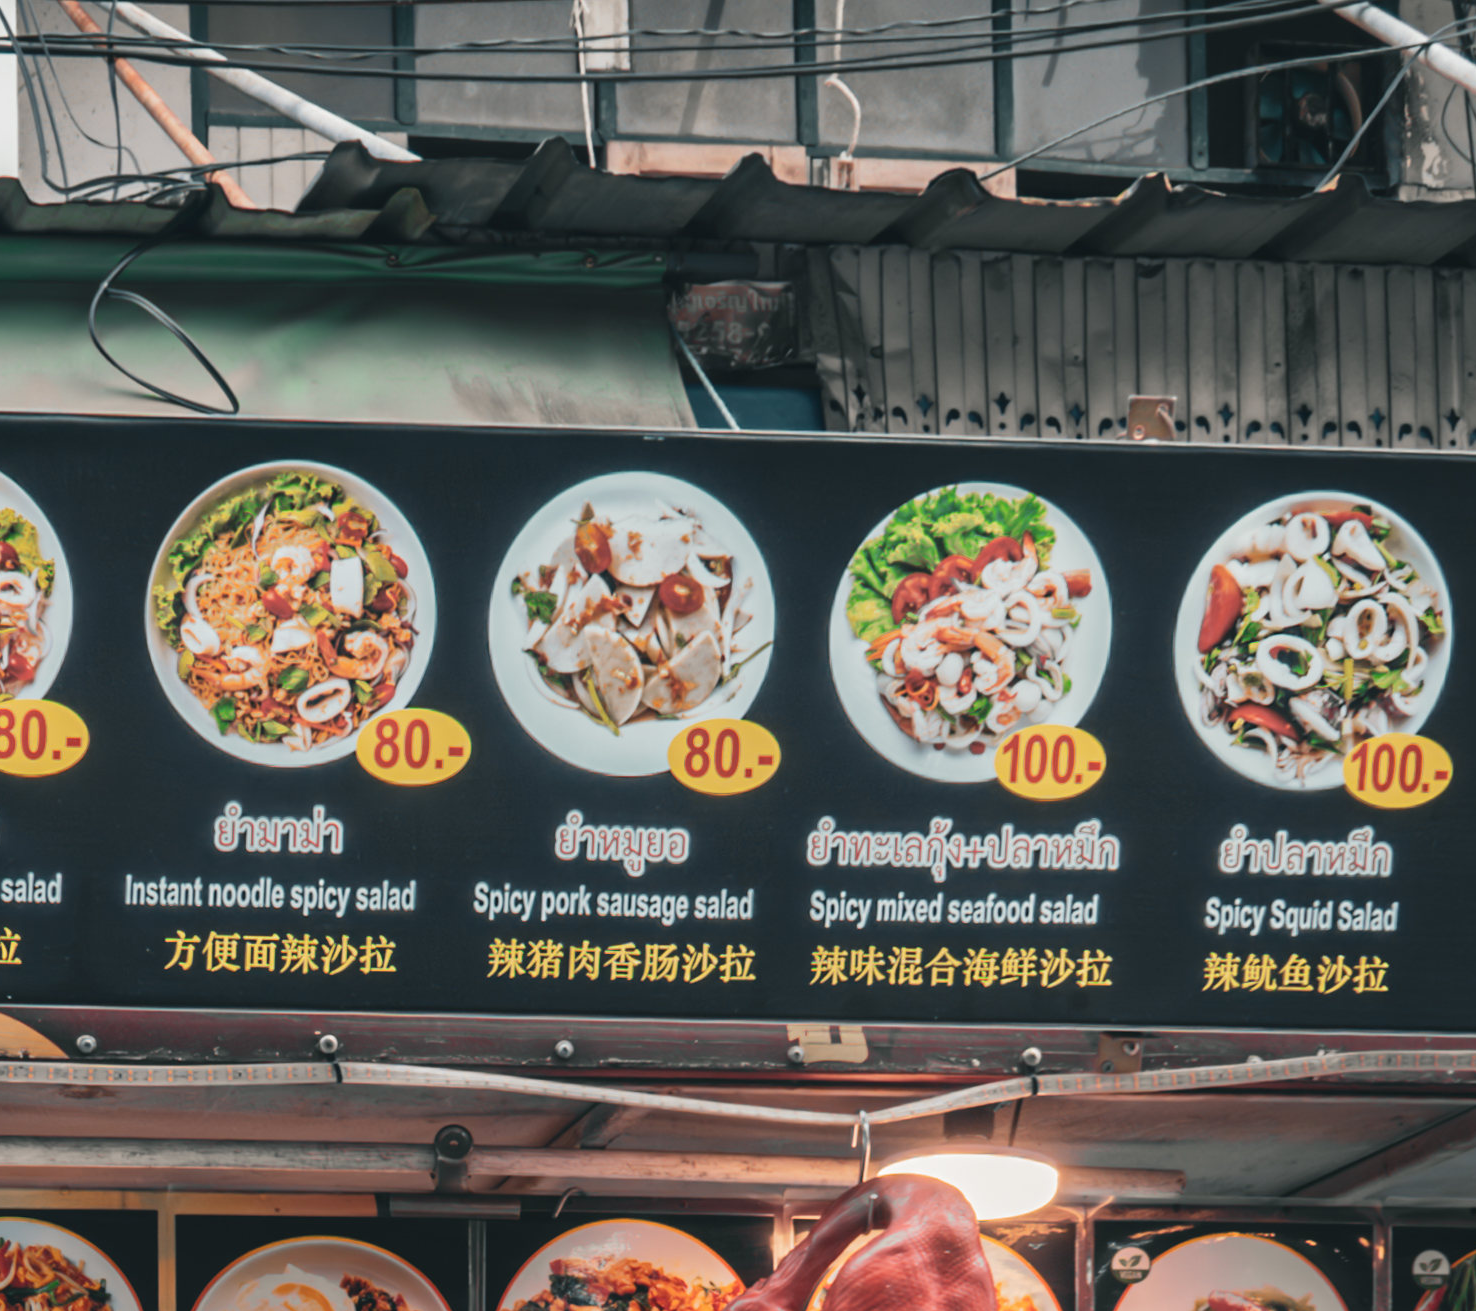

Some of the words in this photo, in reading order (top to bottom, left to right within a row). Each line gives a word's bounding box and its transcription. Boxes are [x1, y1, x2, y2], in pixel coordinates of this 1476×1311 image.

[214, 801, 344, 854] ยำมาม่า
[0, 872, 62, 904] salad
[125, 874, 203, 906] Instant
[208, 877, 285, 908] noodle
[290, 879, 351, 916] spicy
[356, 880, 416, 911] salad
[474, 882, 536, 922] Spicy
[541, 885, 591, 922] pork
[597, 893, 689, 926] sausage
[694, 889, 754, 920] salad
[1205, 897, 1266, 936] Spicy
[1270, 899, 1333, 936] Squid
[1337, 900, 1399, 931] Salad
[165, 930, 396, 975] 方便面辣沙拉
[487, 938, 756, 983] 辣猪肉香肠沙拉
[1202, 952, 1389, 994] 辣鱿鱼沙拉
